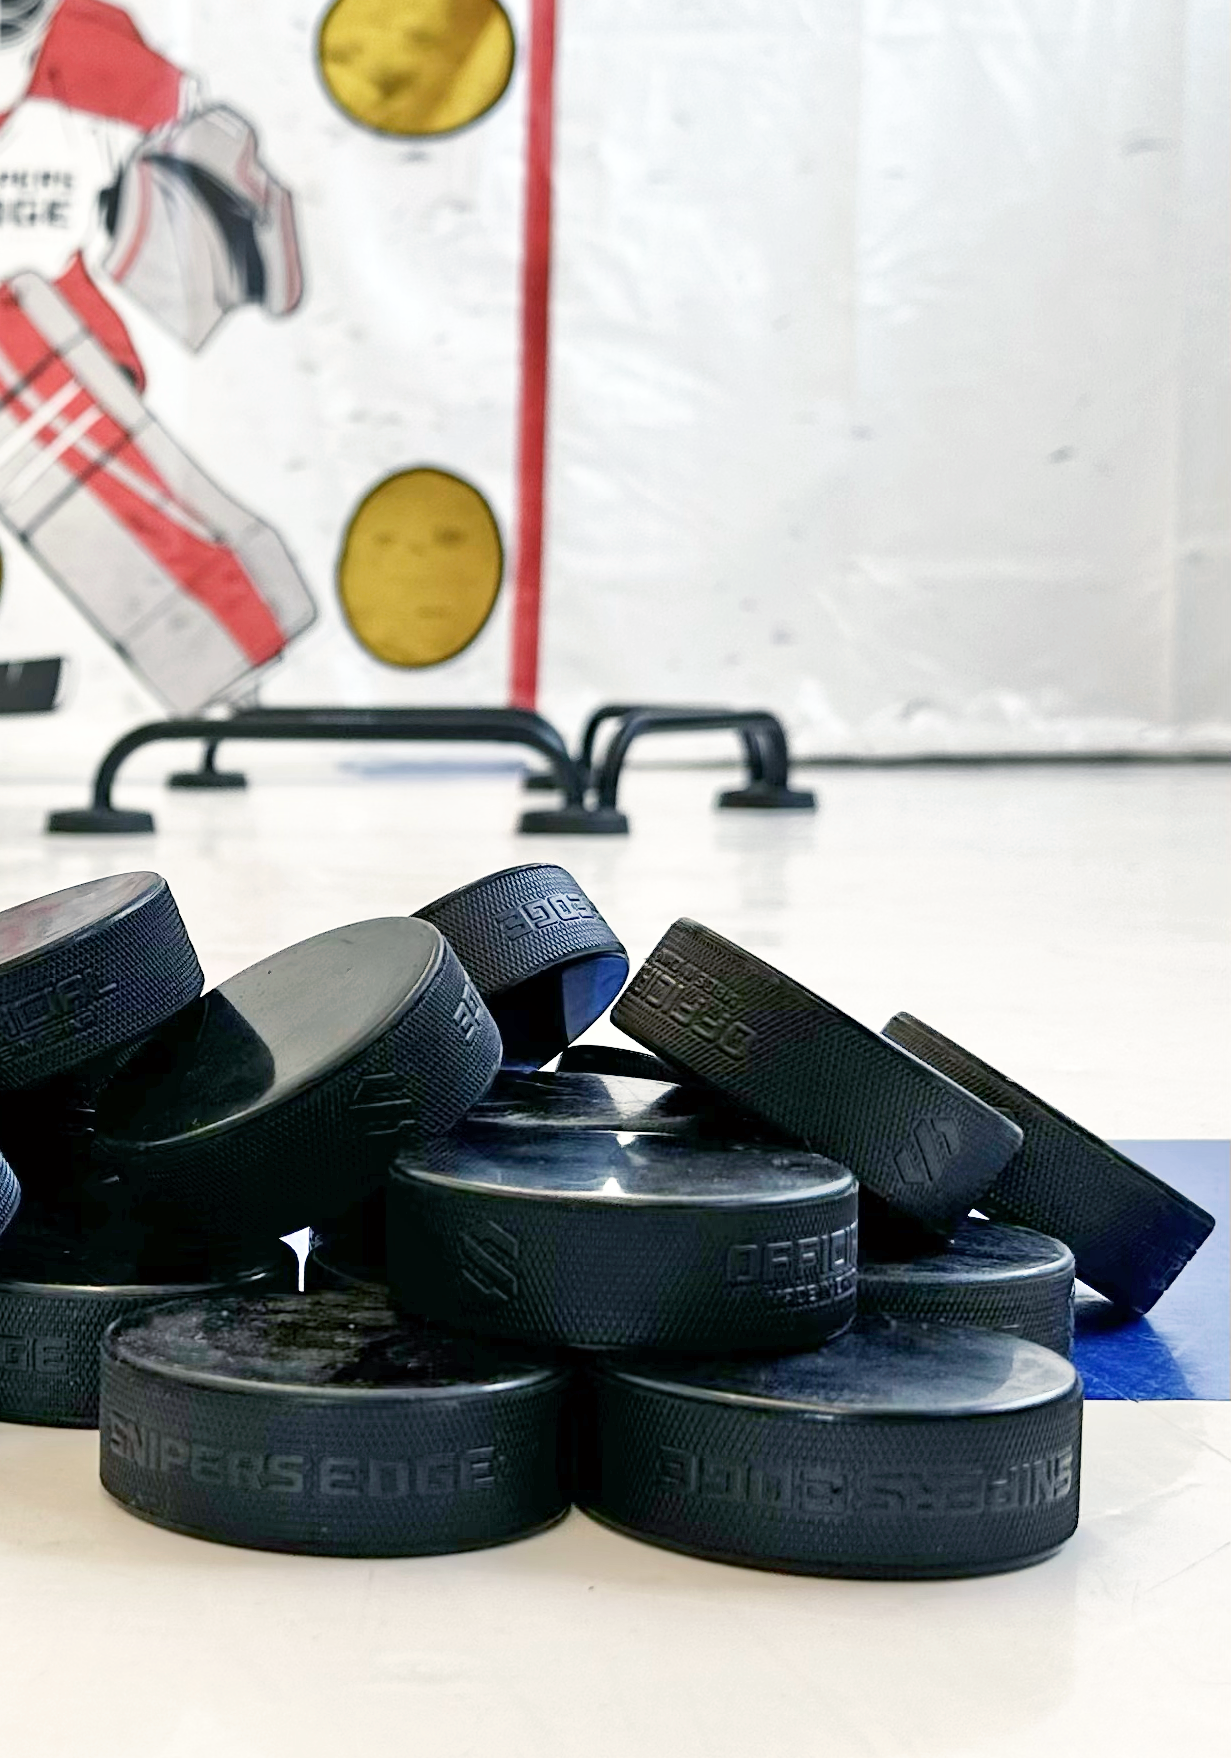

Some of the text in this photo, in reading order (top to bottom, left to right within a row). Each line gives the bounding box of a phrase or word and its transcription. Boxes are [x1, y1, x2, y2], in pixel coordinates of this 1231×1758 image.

[497, 893, 595, 942] EDGE
[109, 1410, 496, 1497] SNIPERS EDGE
